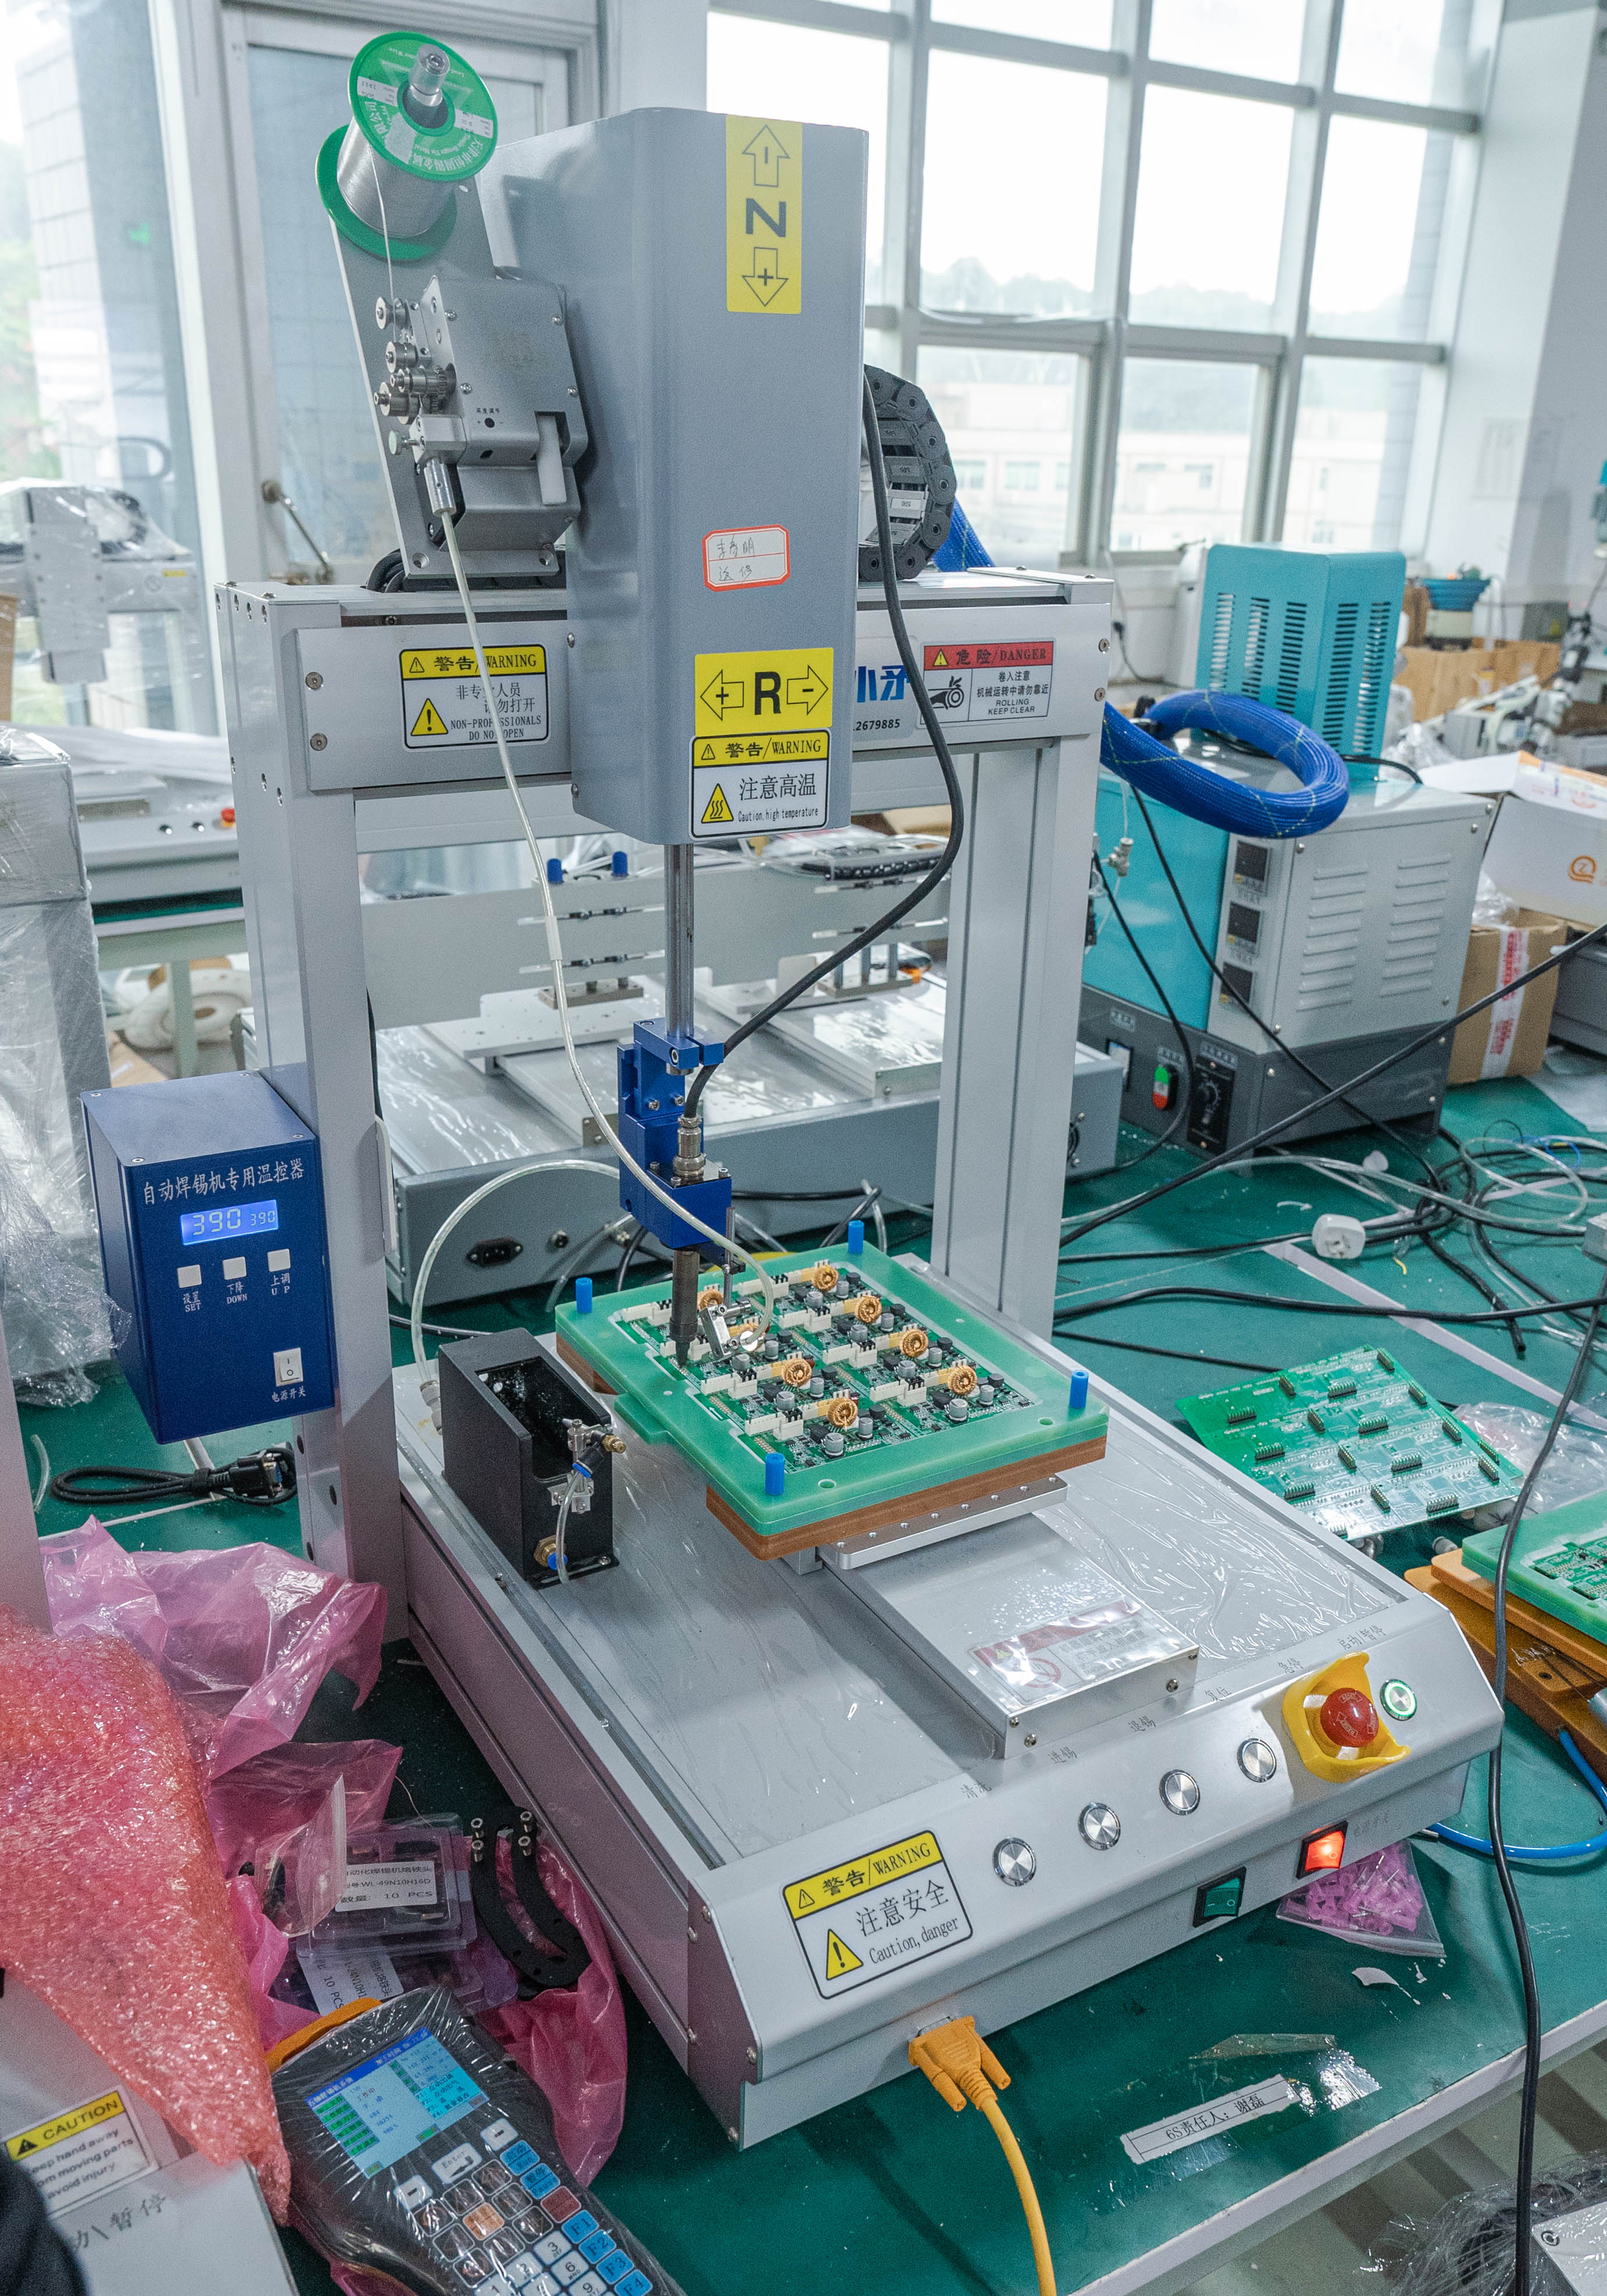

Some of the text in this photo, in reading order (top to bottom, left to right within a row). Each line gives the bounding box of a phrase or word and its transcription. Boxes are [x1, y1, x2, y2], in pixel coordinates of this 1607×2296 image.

[998, 670, 1030, 682] 卷入注意
[456, 682, 521, 700] 非专人员
[755, 672, 781, 715] R
[977, 684, 1049, 698] 机械运转中请勿靠近
[451, 715, 541, 730] NON-PROFSSIONALS
[853, 719, 900, 731] 2679885
[469, 731, 480, 741] DO
[483, 730, 495, 741] NO
[740, 773, 816, 801] 注意高温
[766, 809, 780, 822] high
[782, 807, 818, 820] temperature
[144, 1158, 305, 1205] 自动焊锡机专用温控器
[193, 1209, 276, 1236] 390 390
[183, 1273, 291, 1305] 设置 下降 上调
[185, 1302, 201, 1313] SET
[227, 1292, 248, 1304] DOWN
[272, 1387, 306, 1403] 电源开关
[1279, 1657, 1304, 1674] 急停
[1205, 1687, 1232, 1701] 复位
[1128, 1715, 1156, 1731] 退锡
[1048, 1746, 1077, 1764] 进锡
[960, 1780, 992, 1799] 清洗
[856, 1880, 949, 1937] 注意安全
[869, 1918, 959, 1964] Caution, danger
[323, 1976, 335, 1987] 10
[43, 2100, 119, 2140] CAUTION
[31, 2129, 119, 2174] eep hand away
[59, 2153, 101, 2177] moving
[103, 2138, 134, 2158] parts
[83, 2162, 115, 2182] injury
[571, 2218, 591, 2236] F1
[548, 2242, 559, 2252] 3
[588, 2238, 609, 2256] F2
[565, 2262, 576, 2272] 6
[605, 2257, 626, 2276] F3
[583, 2282, 593, 2294] 9
[623, 2277, 644, 2296] F4
